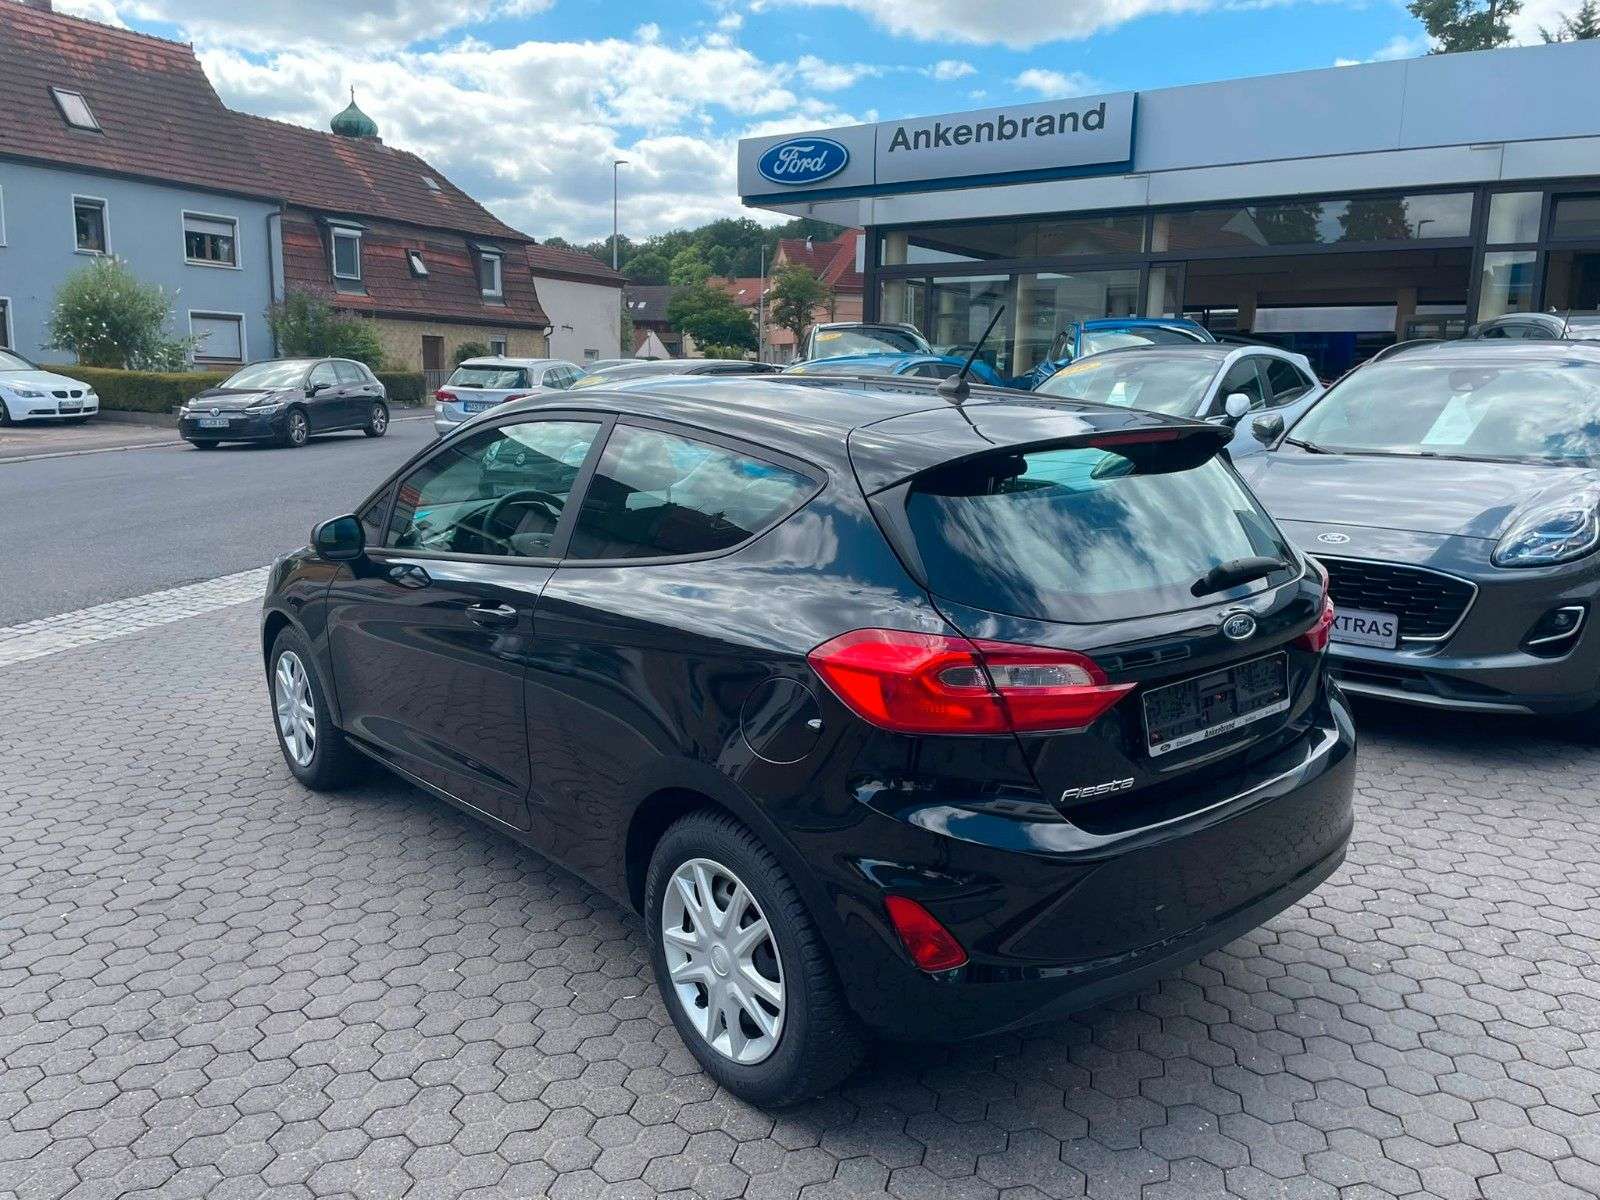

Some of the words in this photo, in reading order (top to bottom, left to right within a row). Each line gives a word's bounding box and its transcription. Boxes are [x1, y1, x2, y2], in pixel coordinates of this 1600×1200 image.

[888, 102, 1106, 153] Ankenbrand
[772, 145, 827, 175] Ford
[1061, 777, 1135, 802] Fiesta
